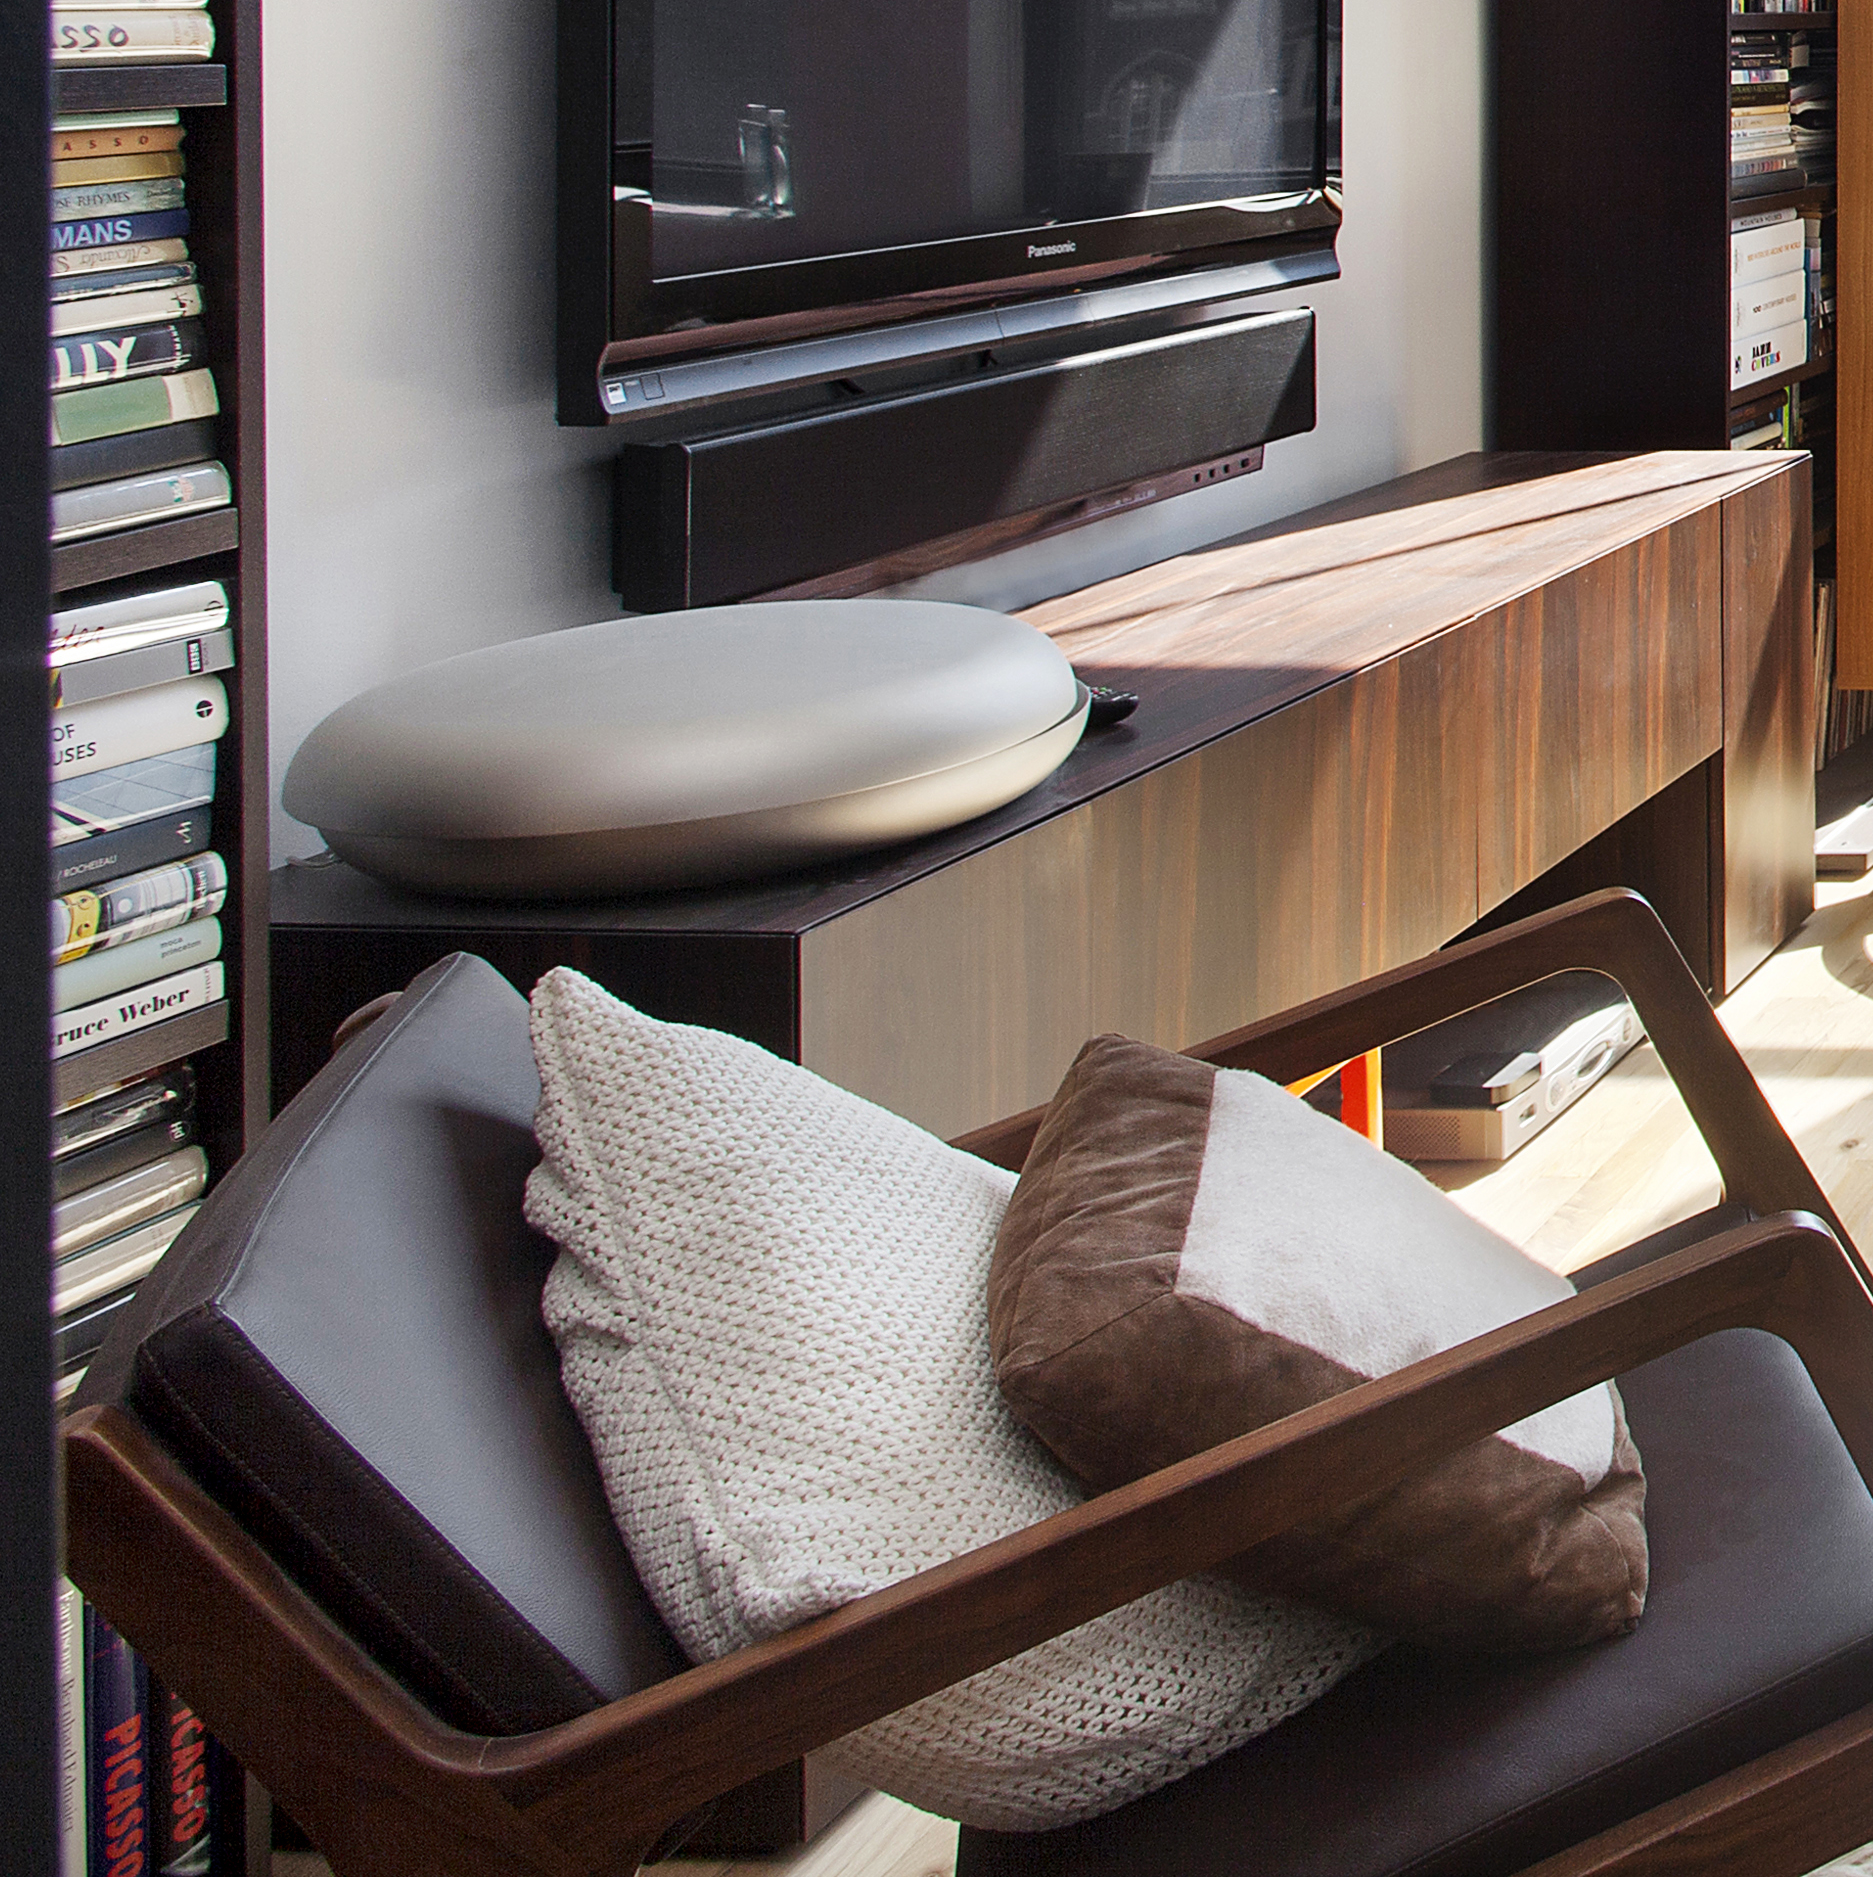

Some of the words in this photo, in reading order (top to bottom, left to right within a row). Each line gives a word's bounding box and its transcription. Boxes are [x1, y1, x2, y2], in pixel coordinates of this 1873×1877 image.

[77, 191, 131, 207] RHYMES
[52, 218, 132, 249] MANS
[1028, 239, 1076, 259] Panasonic
[80, 245, 150, 267] Alexander
[54, 336, 137, 389] LLY
[1751, 351, 1781, 371] COVERS
[1752, 341, 1772, 358] JAZZ
[118, 988, 190, 1023] Weber
[62, 1677, 77, 1760] Bernhard
[170, 1707, 207, 1843] ICASSO
[104, 1713, 145, 1877] PICASSO
